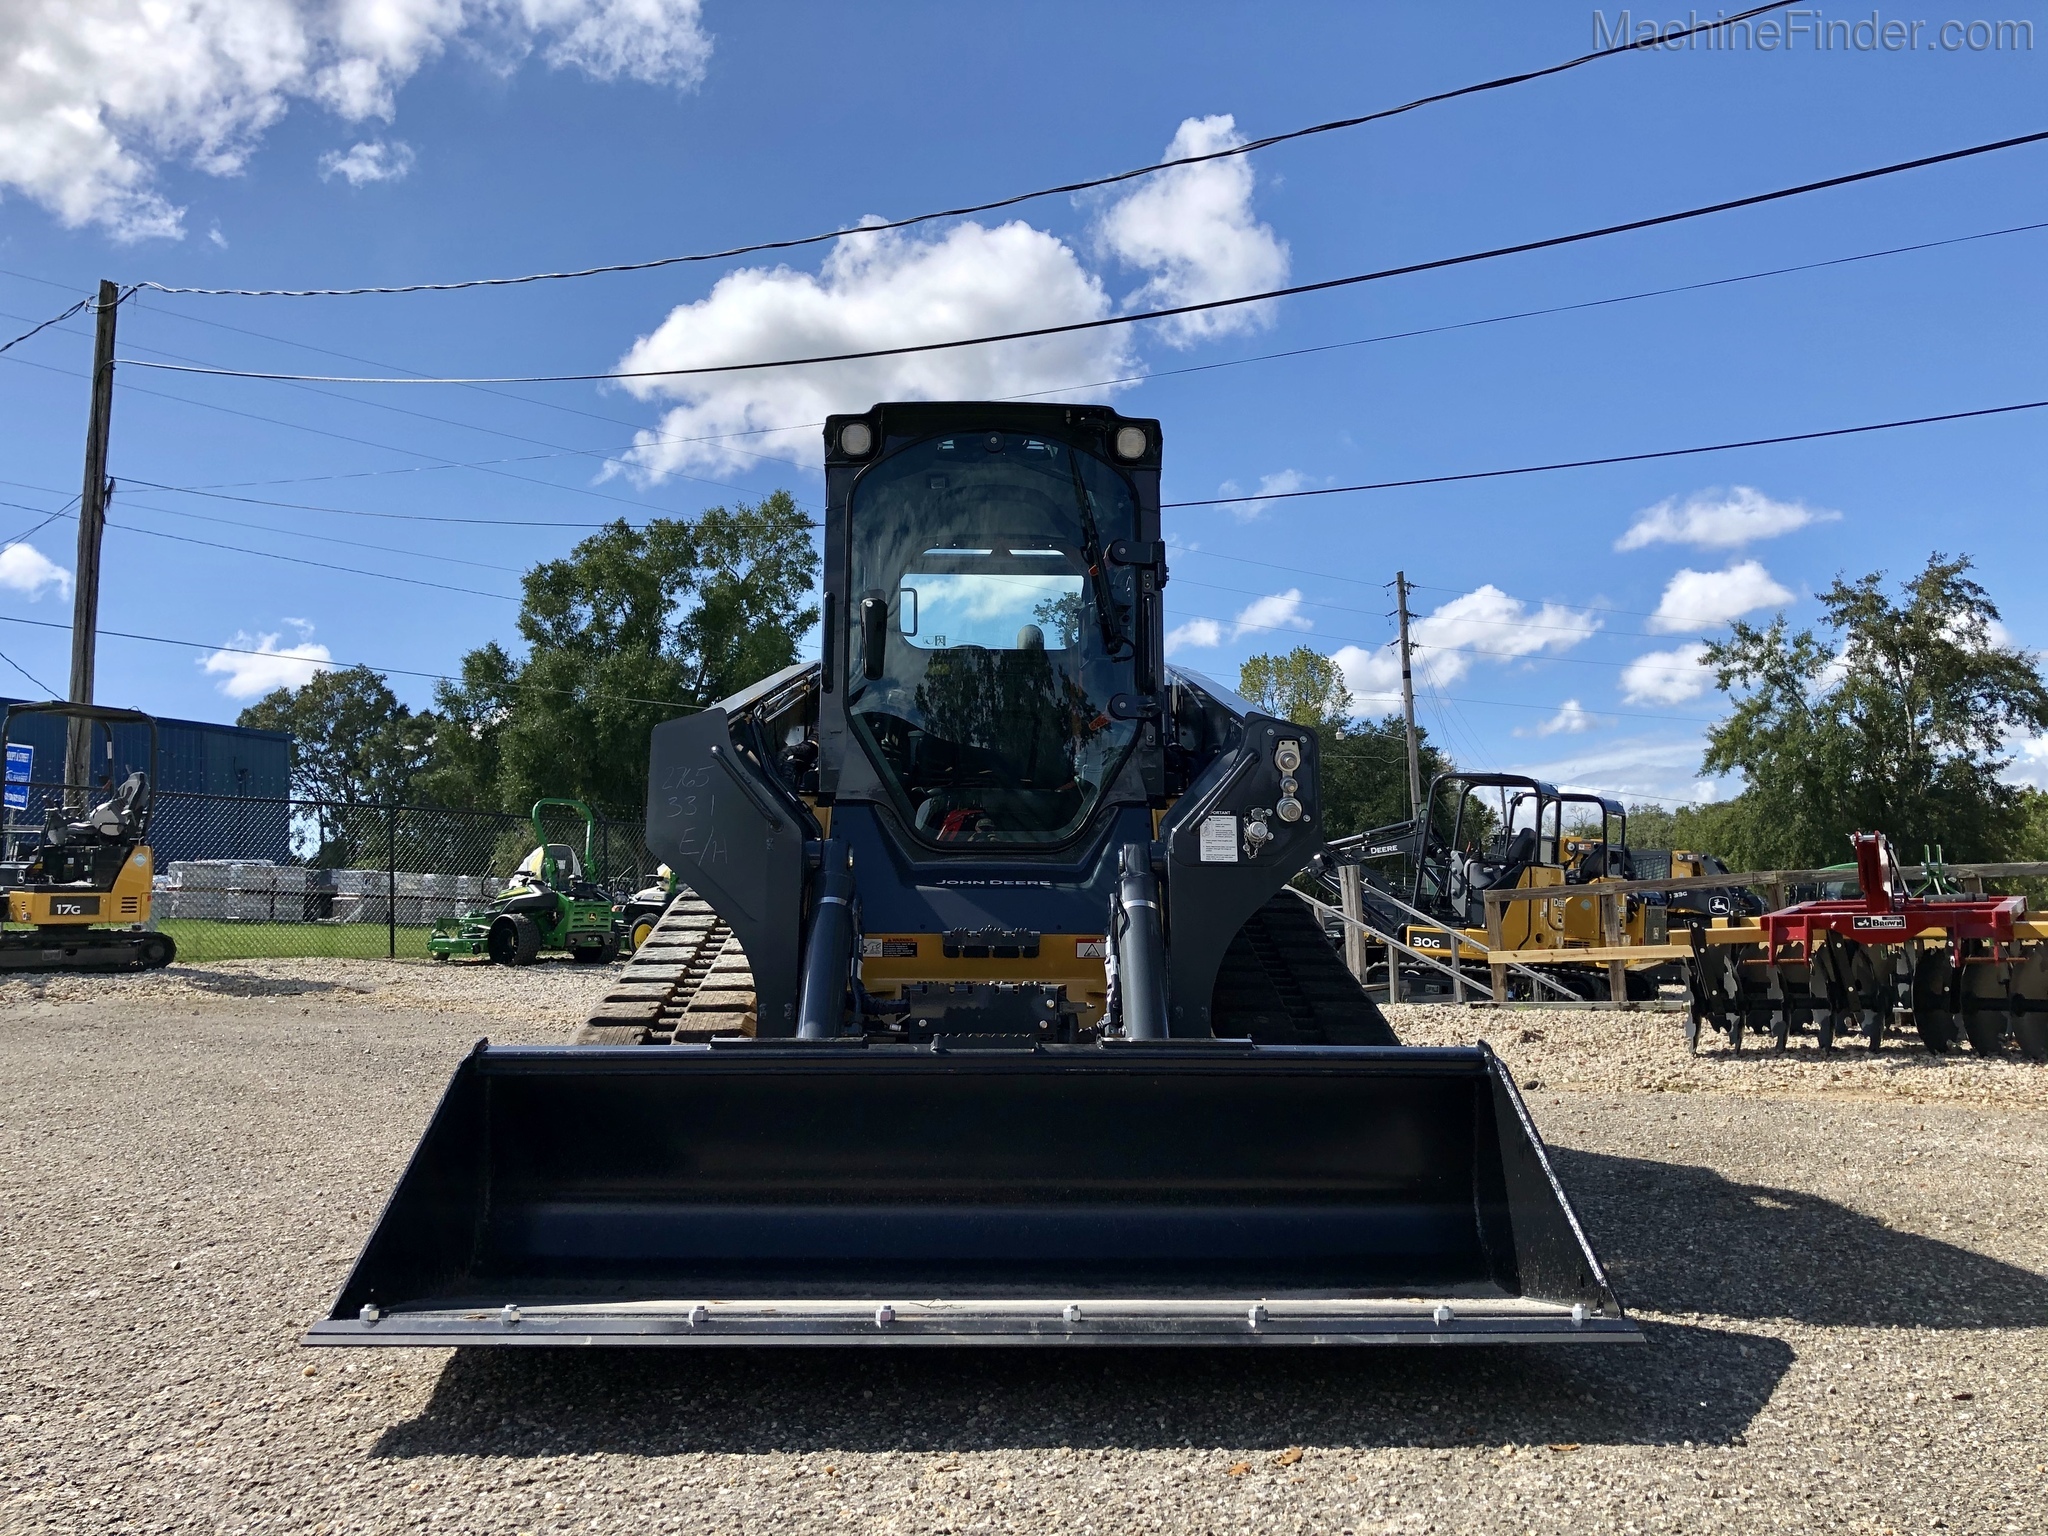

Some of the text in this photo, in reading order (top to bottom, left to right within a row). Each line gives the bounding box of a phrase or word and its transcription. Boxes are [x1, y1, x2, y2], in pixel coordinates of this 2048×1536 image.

[1370, 844, 1398, 854] DEERE
[56, 904, 81, 915] 17G
[1413, 936, 1440, 949] 30G
